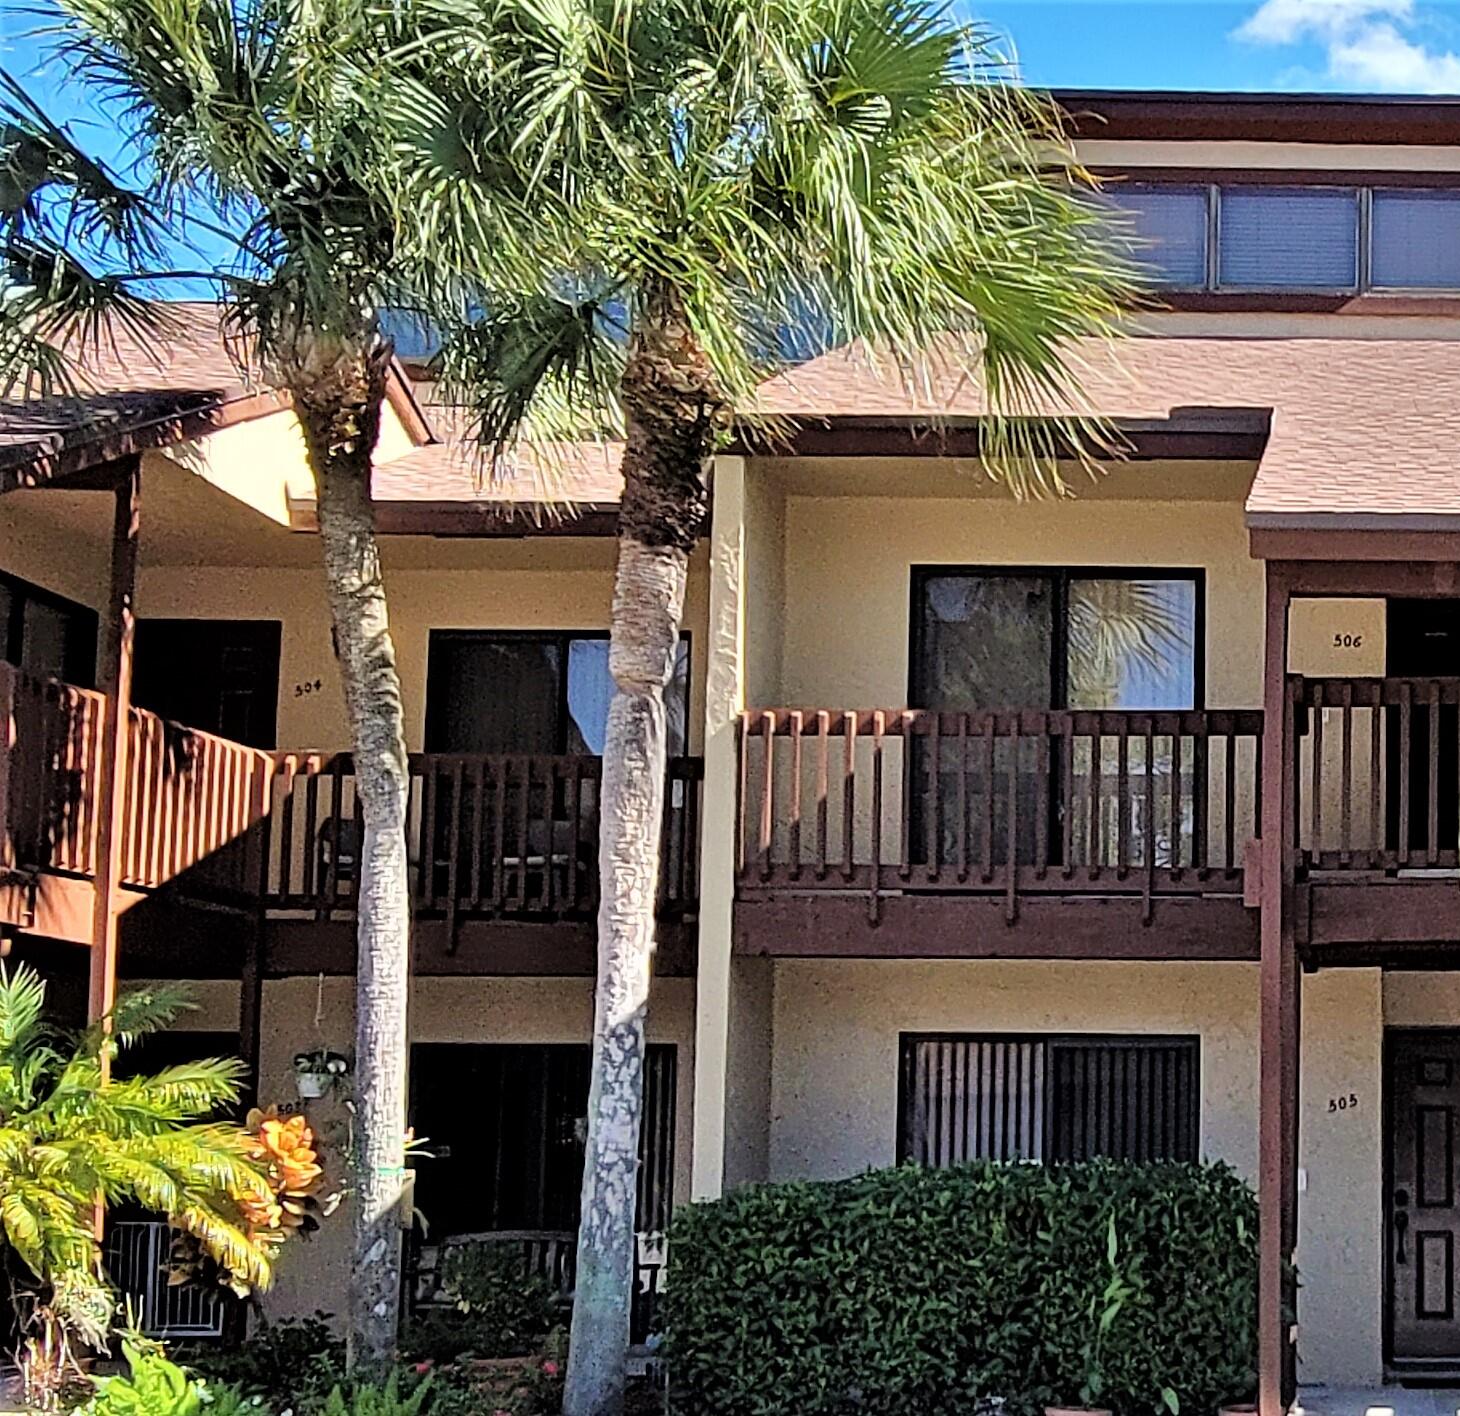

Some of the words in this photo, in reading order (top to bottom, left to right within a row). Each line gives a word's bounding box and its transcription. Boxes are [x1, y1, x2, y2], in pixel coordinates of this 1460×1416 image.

[1333, 634, 1362, 648] 506
[294, 679, 322, 698] 504
[1328, 1094, 1358, 1113] 505
